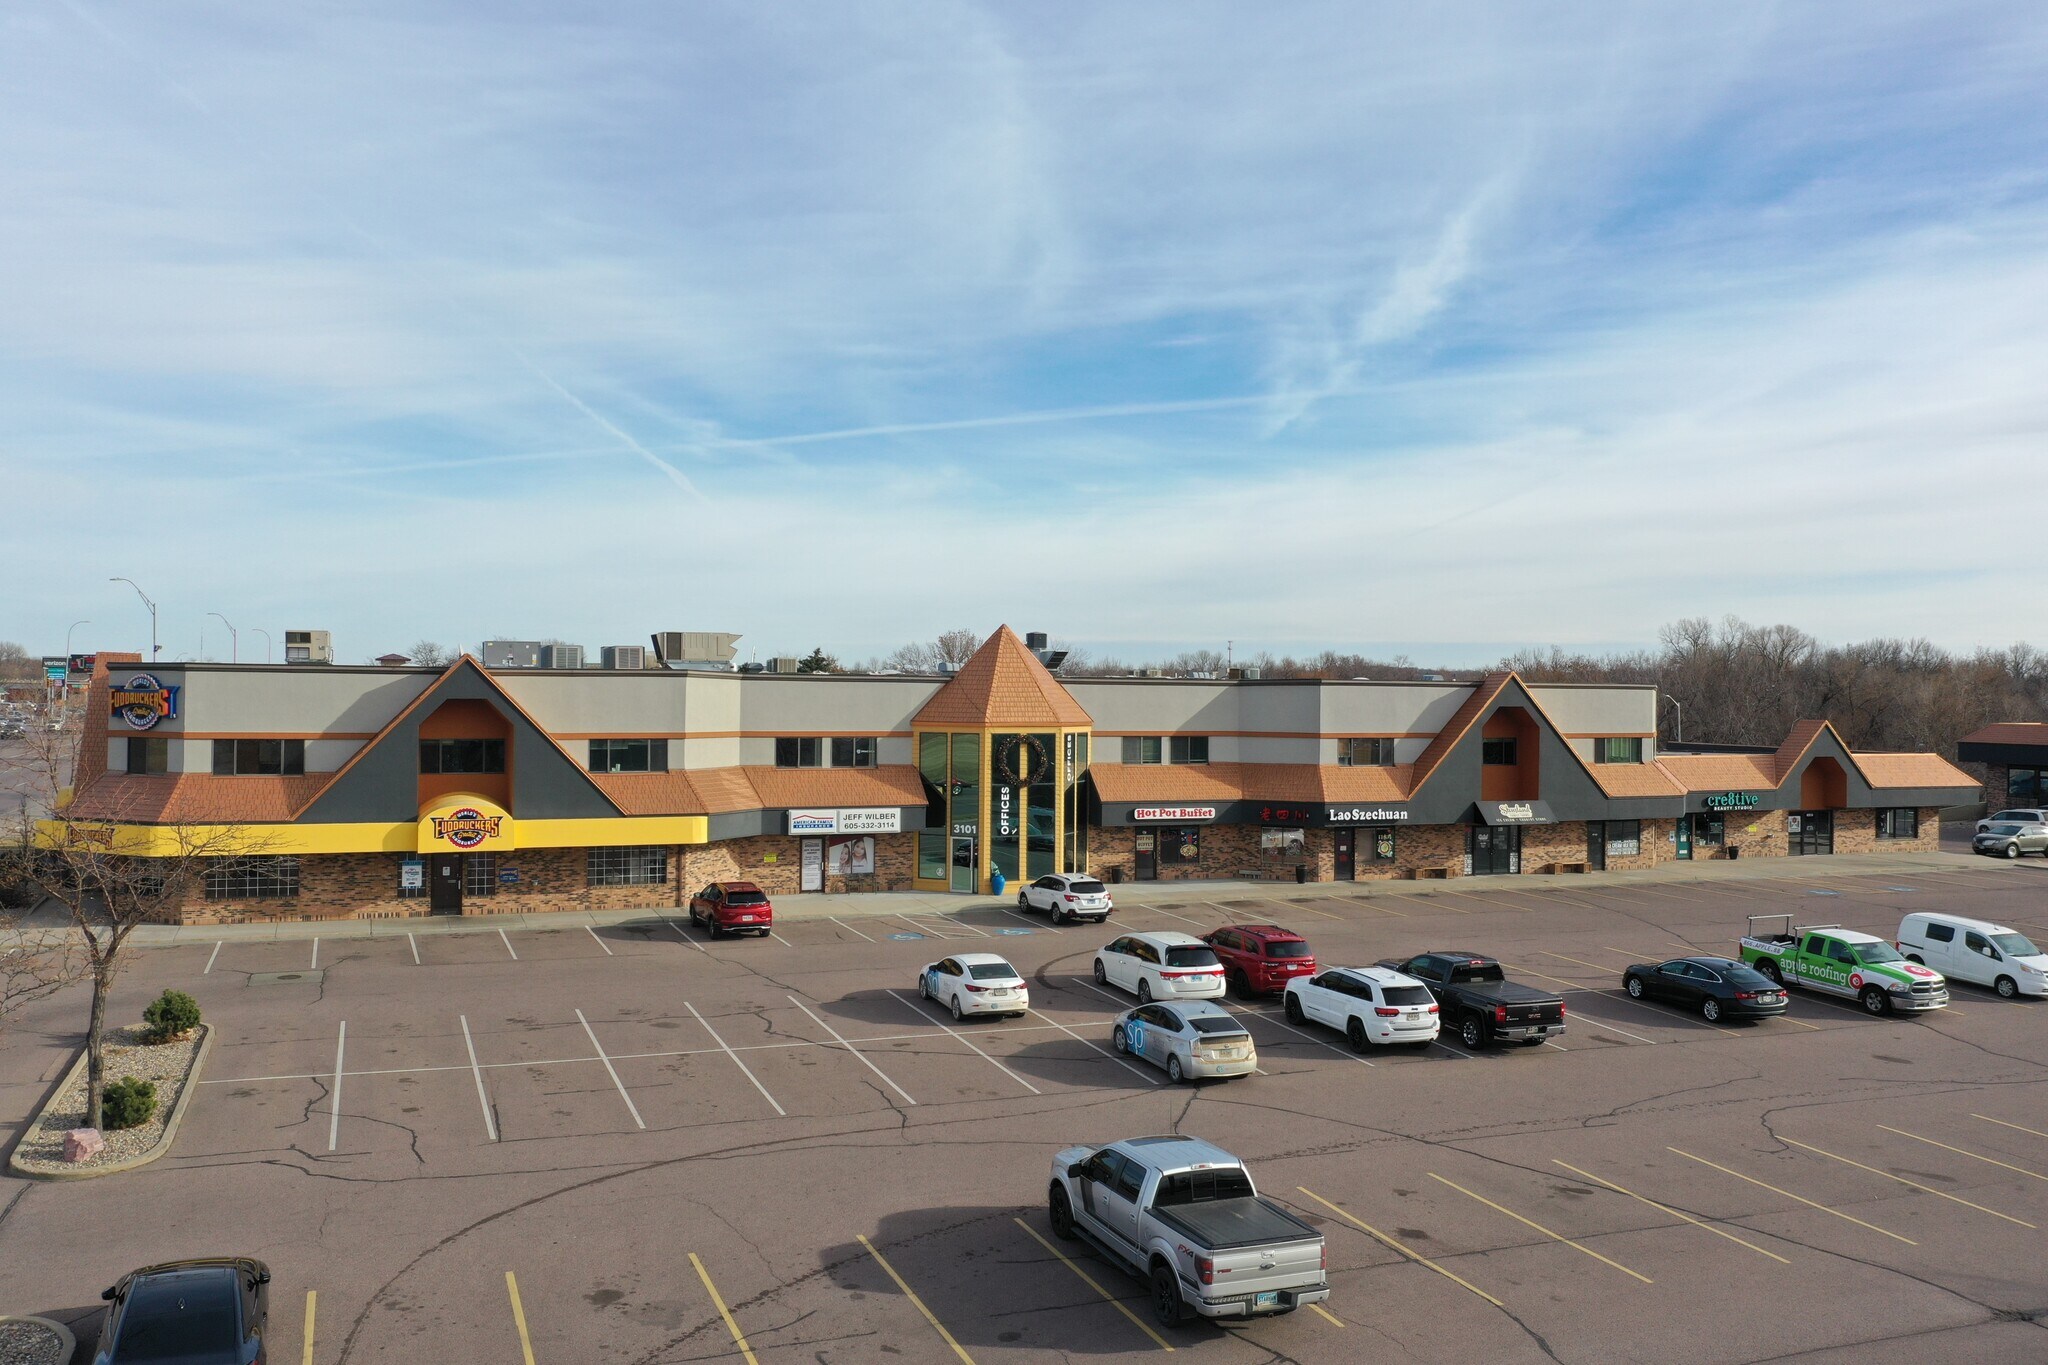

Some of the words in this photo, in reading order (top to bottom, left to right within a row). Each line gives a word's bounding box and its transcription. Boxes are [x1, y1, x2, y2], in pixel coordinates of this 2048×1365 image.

[1707, 792, 1758, 806] cre8tive
[1001, 786, 1009, 835] OFFICES
[1137, 809, 1157, 818] Hot
[1159, 808, 1177, 817] Pot
[1180, 808, 1213, 817] Buffet
[435, 817, 499, 839] FUDDRUCKERS
[953, 824, 977, 834] 3101
[1780, 958, 1807, 973] apple
[1810, 965, 1847, 985] roofing
[1127, 1023, 1145, 1055] sp
[1178, 1244, 1194, 1258] FX4
